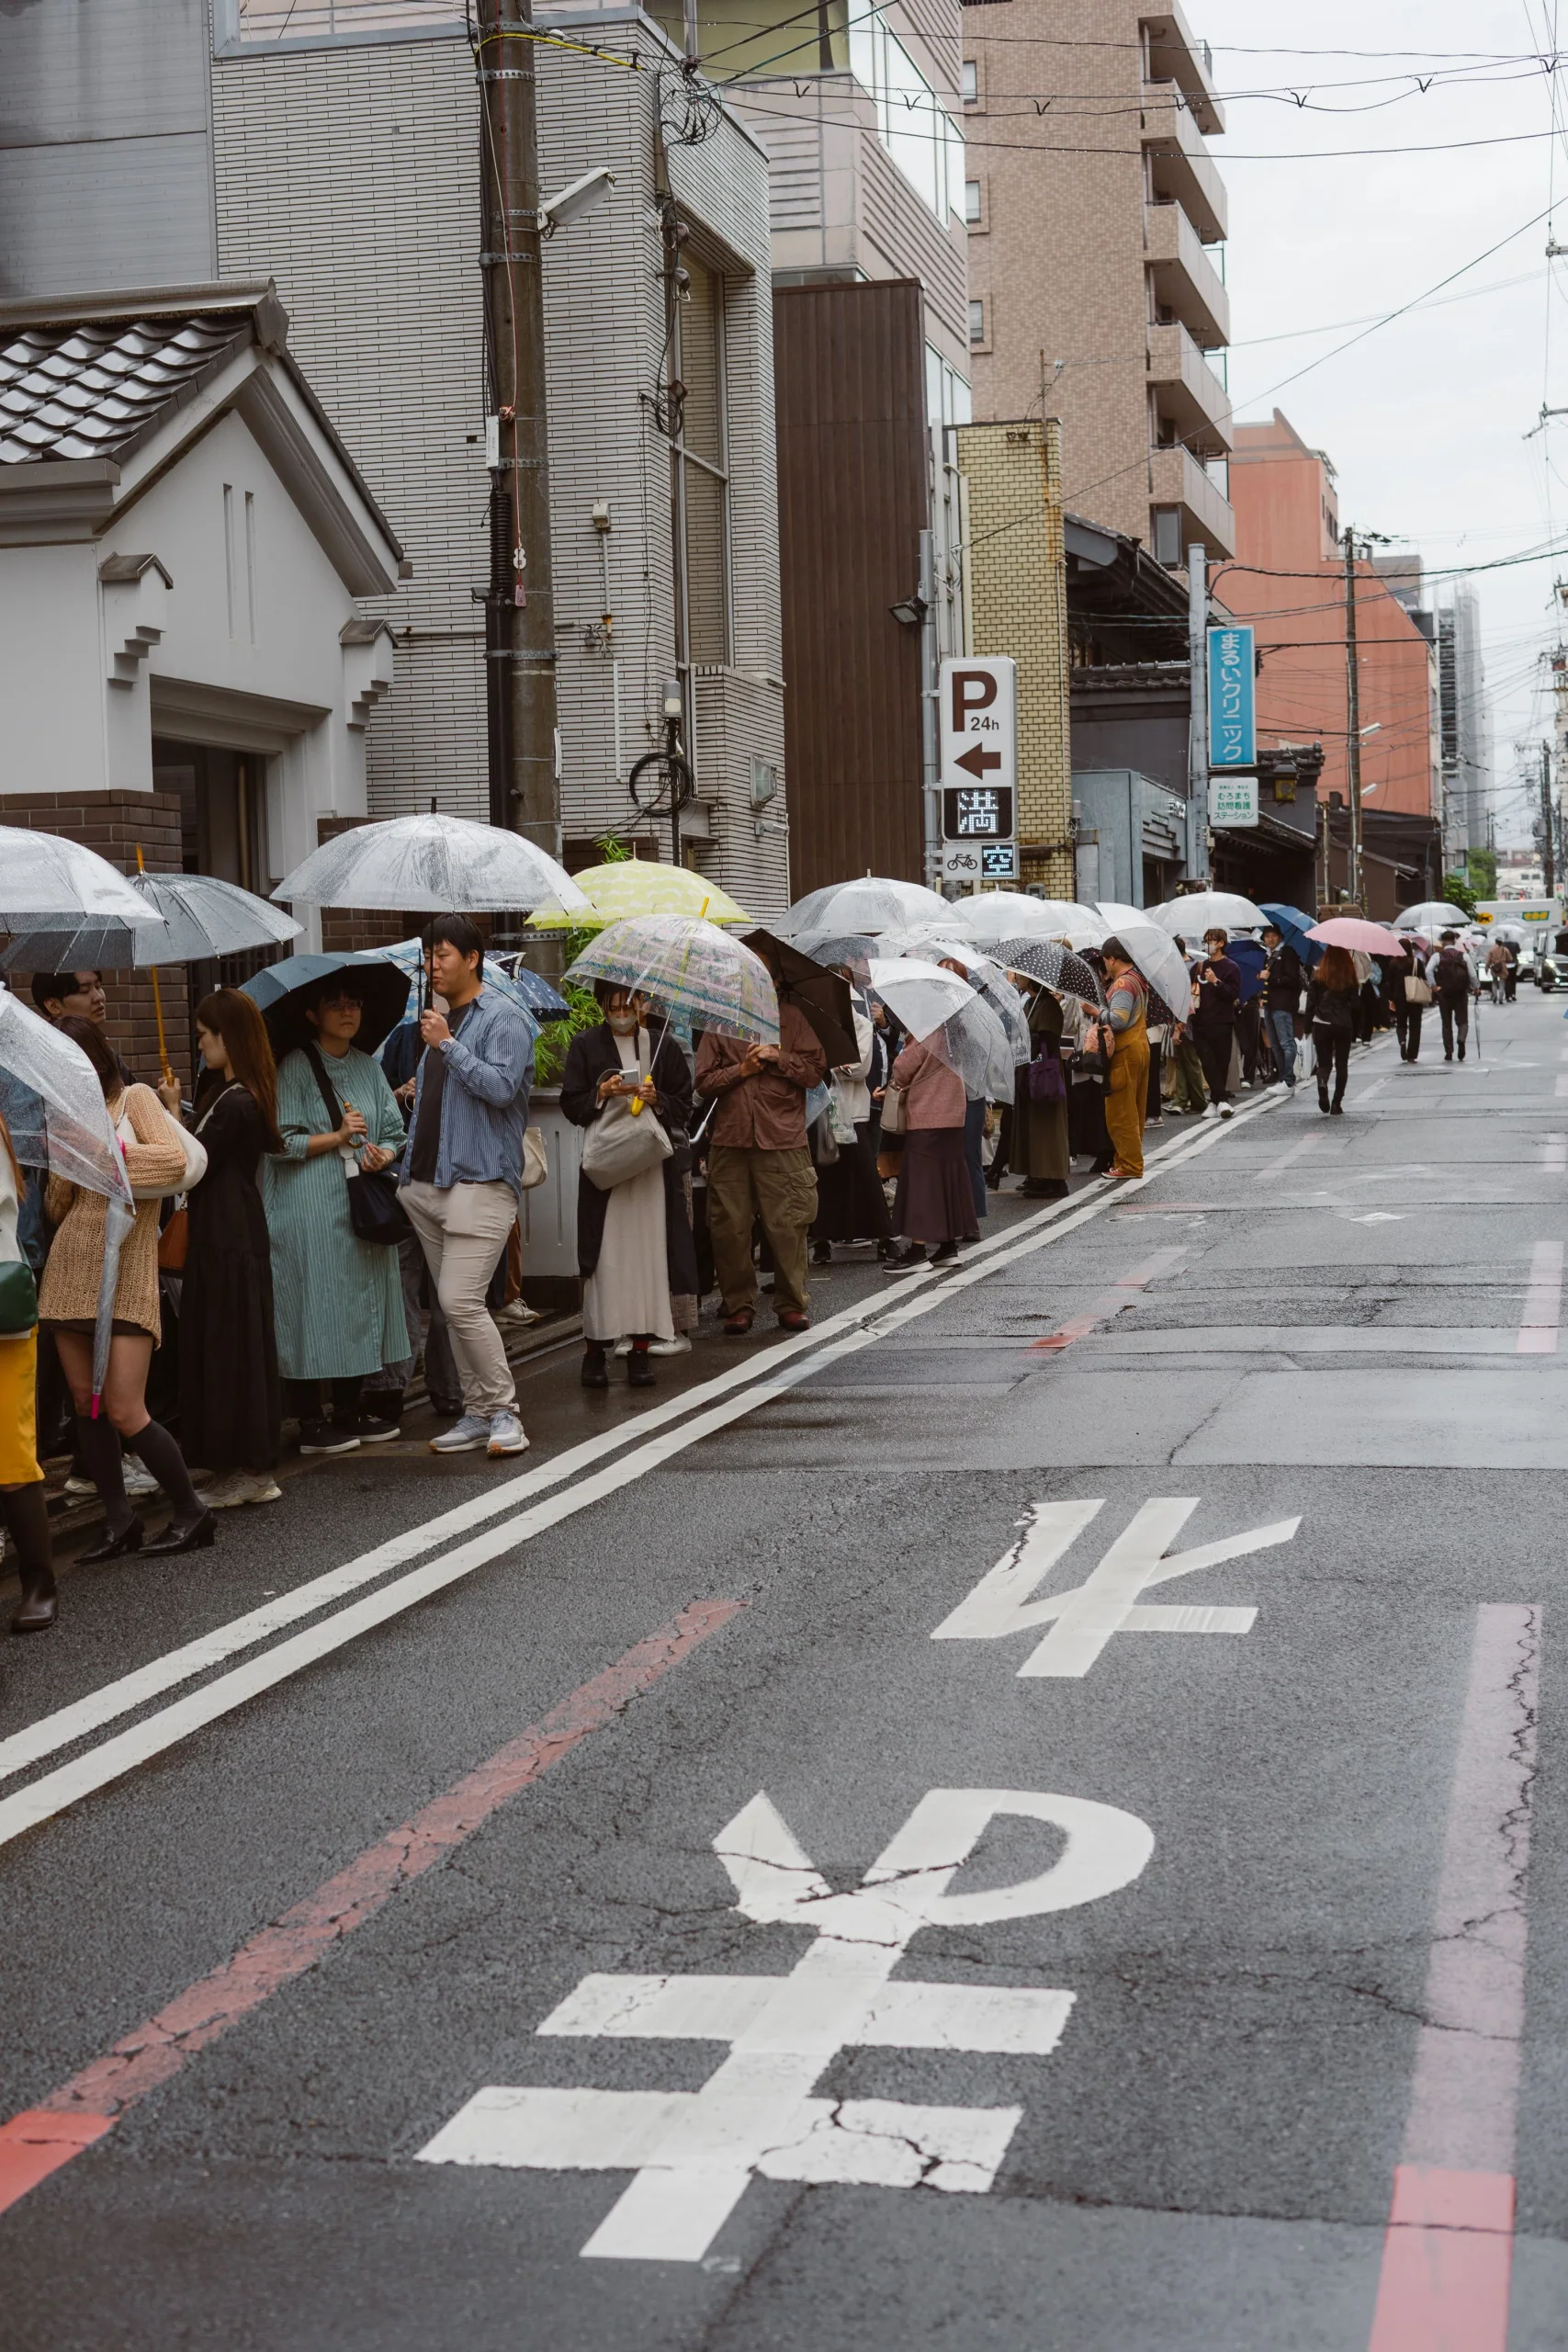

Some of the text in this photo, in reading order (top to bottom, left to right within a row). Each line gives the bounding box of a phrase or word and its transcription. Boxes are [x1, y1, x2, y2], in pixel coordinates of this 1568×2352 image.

[952, 671, 998, 732] P
[1221, 632, 1242, 761] まるいクリニック
[970, 717, 999, 731] 24h
[1217, 801, 1251, 810] 訪問看護
[1218, 792, 1250, 800] むろまち
[958, 791, 998, 834] 満
[1213, 812, 1255, 820] ステーション
[983, 846, 1013, 876] 空
